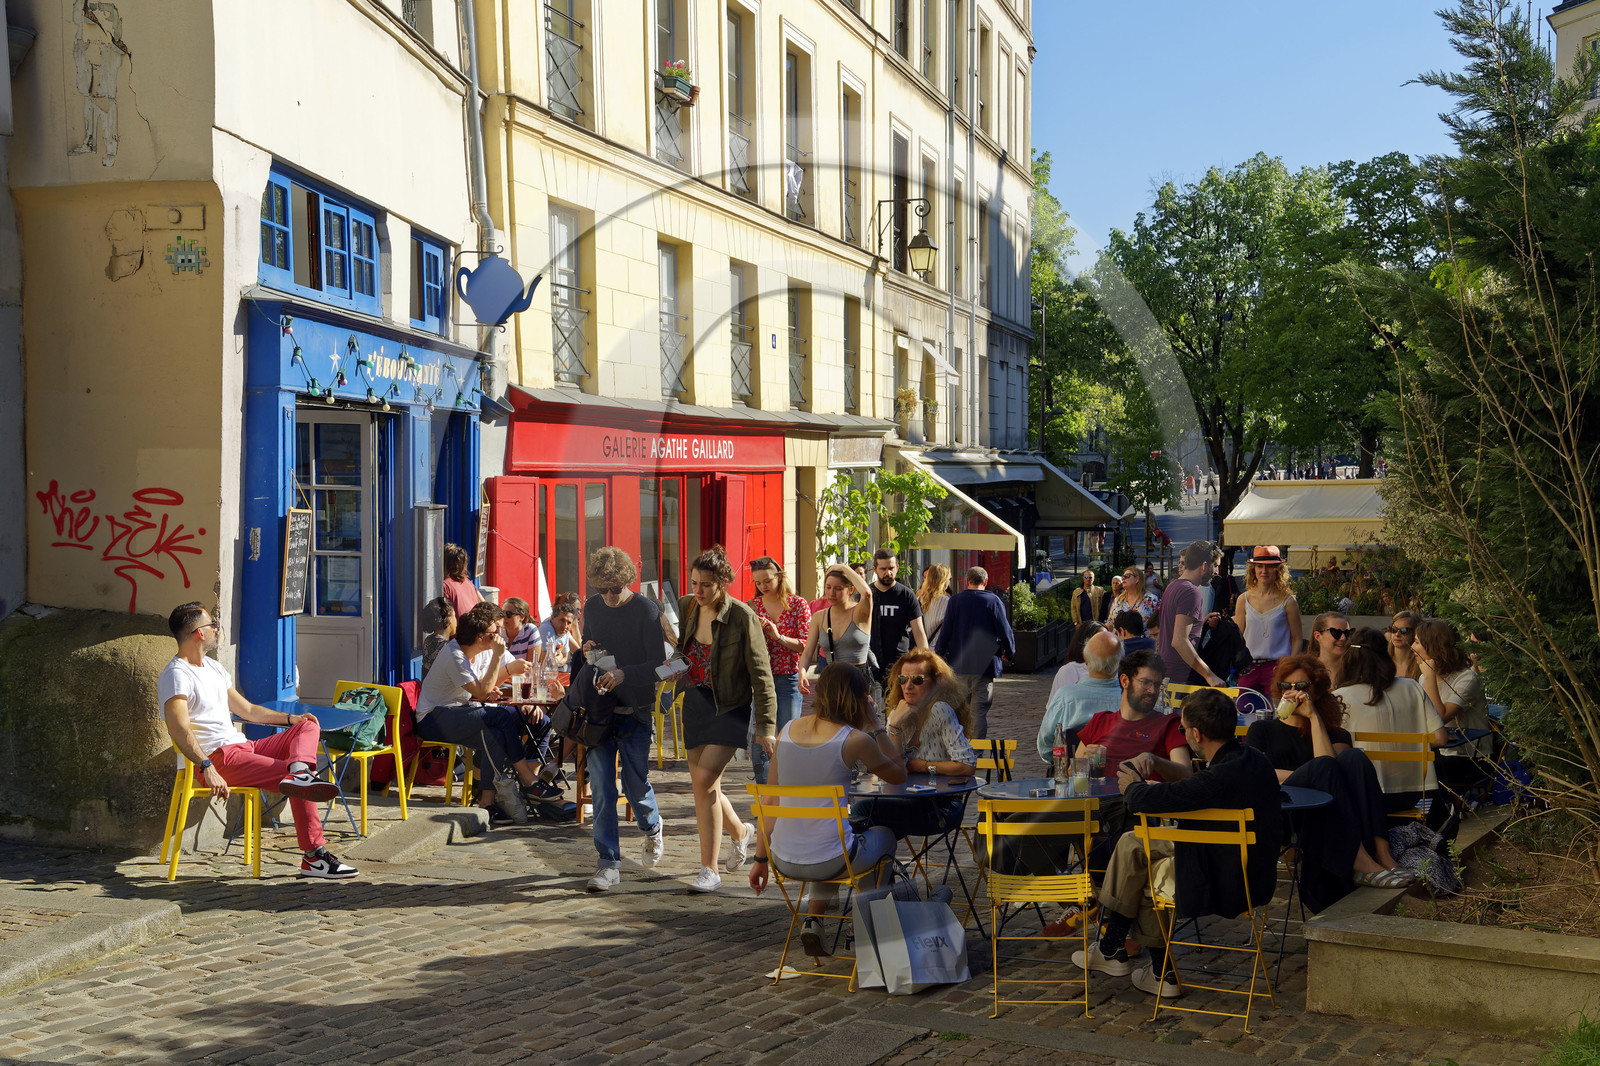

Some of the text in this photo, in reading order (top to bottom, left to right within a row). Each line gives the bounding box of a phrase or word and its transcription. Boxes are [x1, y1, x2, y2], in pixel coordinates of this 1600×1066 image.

[602, 435, 735, 459] GALERIE AGATHE GAILLARD
